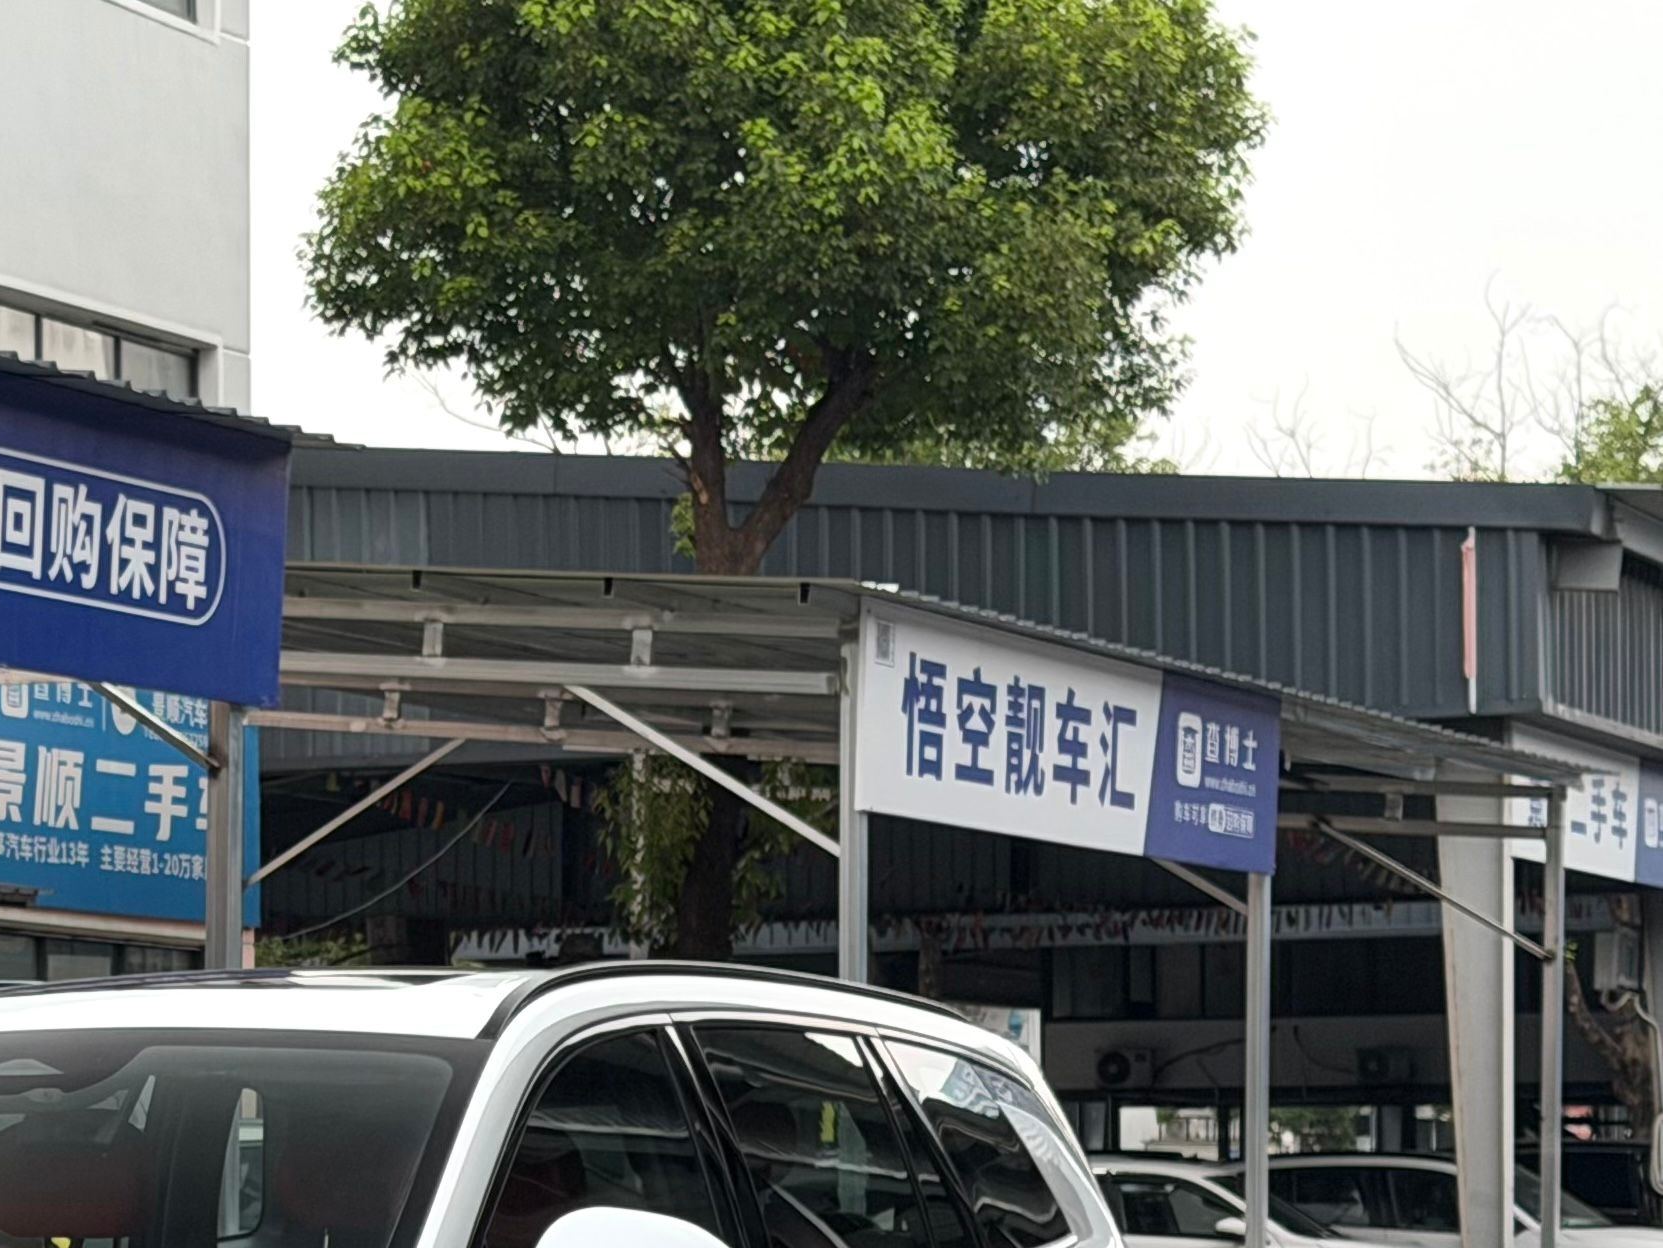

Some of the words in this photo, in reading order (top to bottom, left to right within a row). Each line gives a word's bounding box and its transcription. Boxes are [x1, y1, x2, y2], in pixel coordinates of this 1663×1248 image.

[901, 651, 1137, 811] 悟空靓车汇
[99, 845, 208, 881] 主要经营1-20万家
